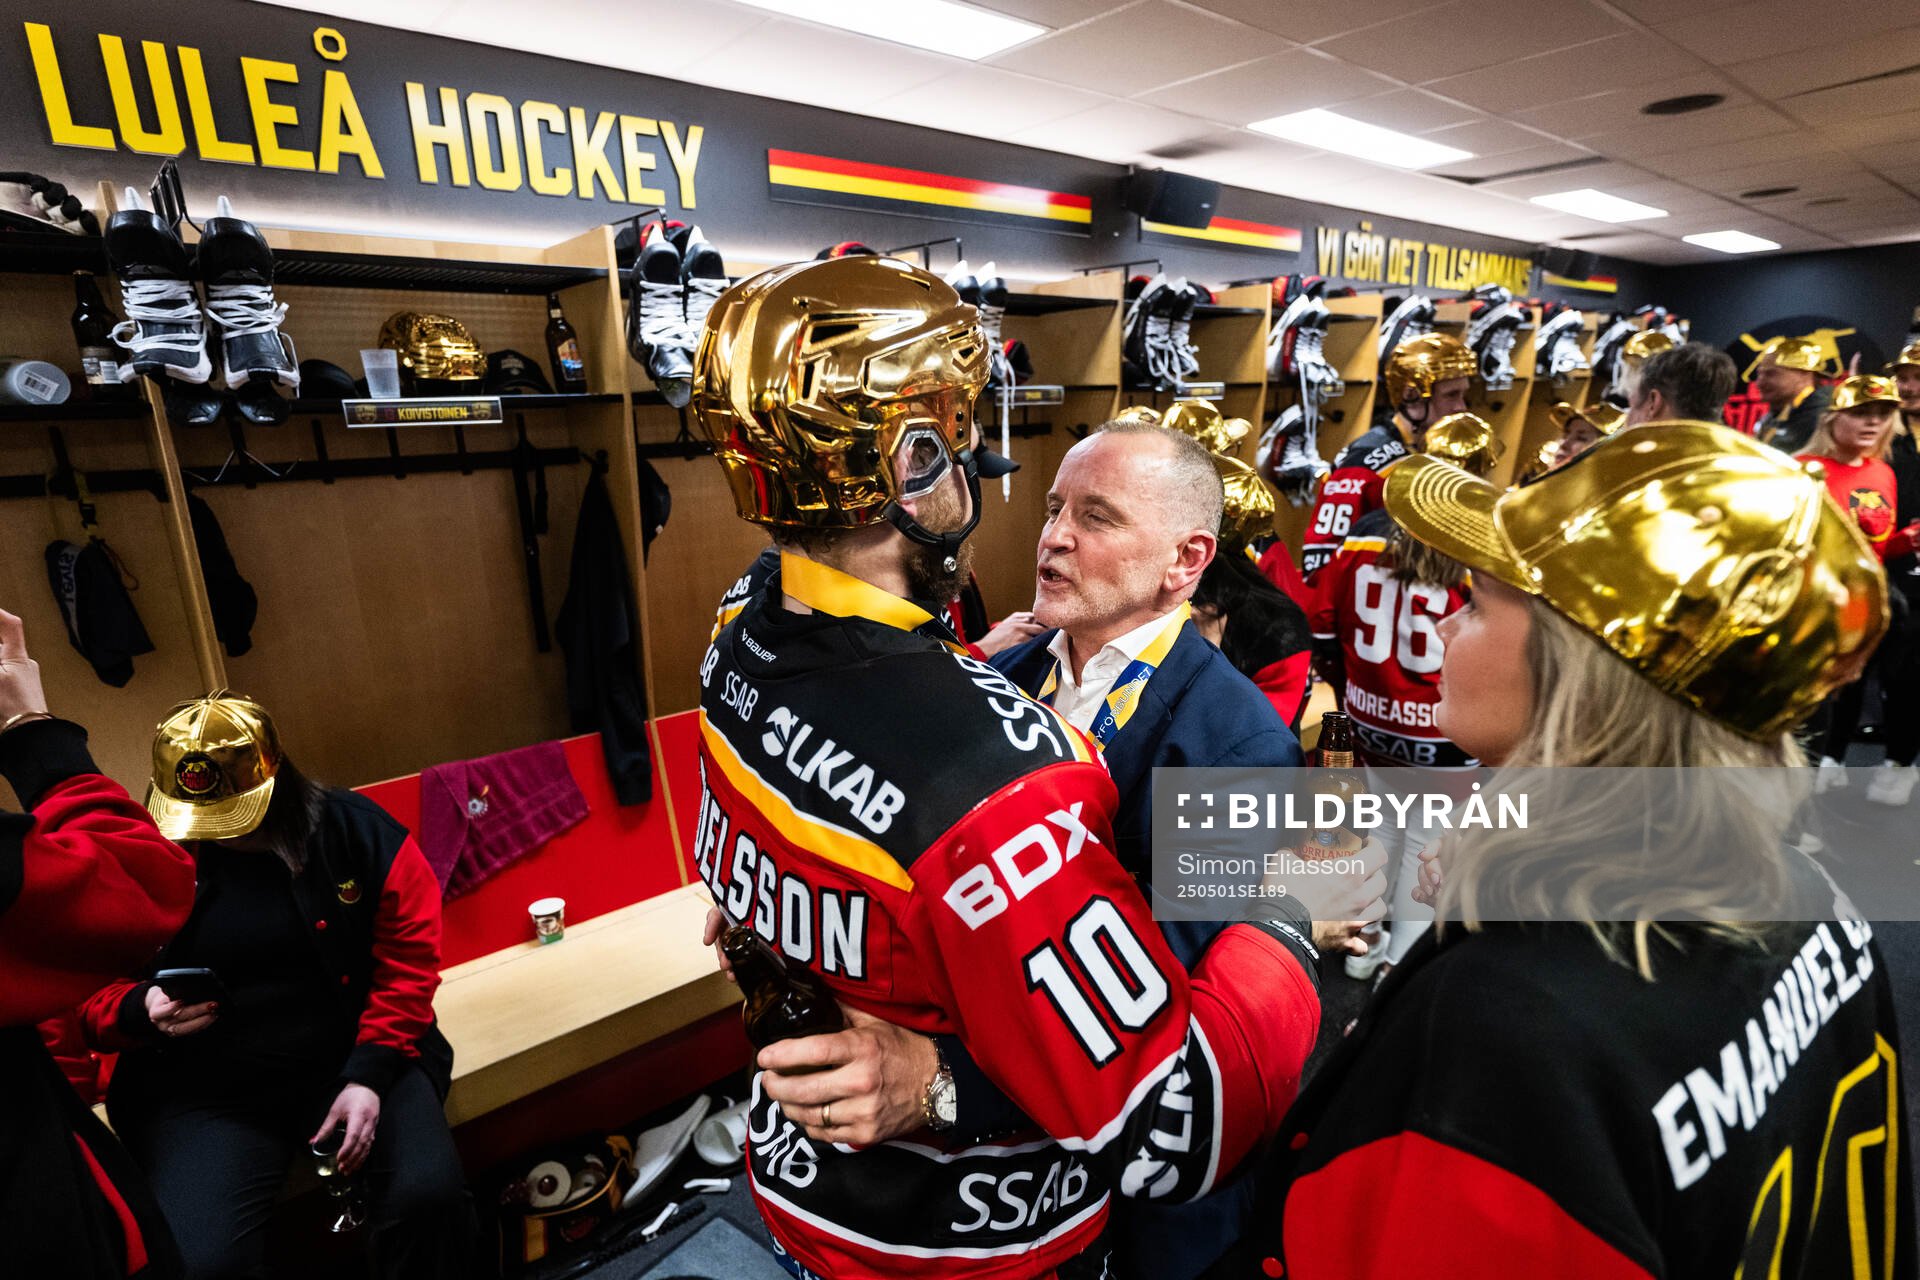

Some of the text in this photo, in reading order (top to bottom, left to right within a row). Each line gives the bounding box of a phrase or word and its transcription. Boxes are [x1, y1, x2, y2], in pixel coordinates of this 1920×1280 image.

[23, 22, 705, 210] LULEÅ HOCKEY
[1317, 221, 1532, 297] VI GÖR DET TILLSAMMANS
[397, 406, 469, 421] KOIVISTOINEN
[1363, 440, 1406, 470] SSAB
[1314, 503, 1354, 537] 96
[1353, 563, 1450, 674] 96
[720, 670, 759, 722] SSAB
[786, 723, 906, 834] LKAB
[1357, 726, 1438, 765] SSAB
[694, 757, 868, 979] UELSSON
[942, 801, 1100, 931] BDX
[1025, 897, 1170, 1067] 10
[951, 1155, 1089, 1233] SSAB
